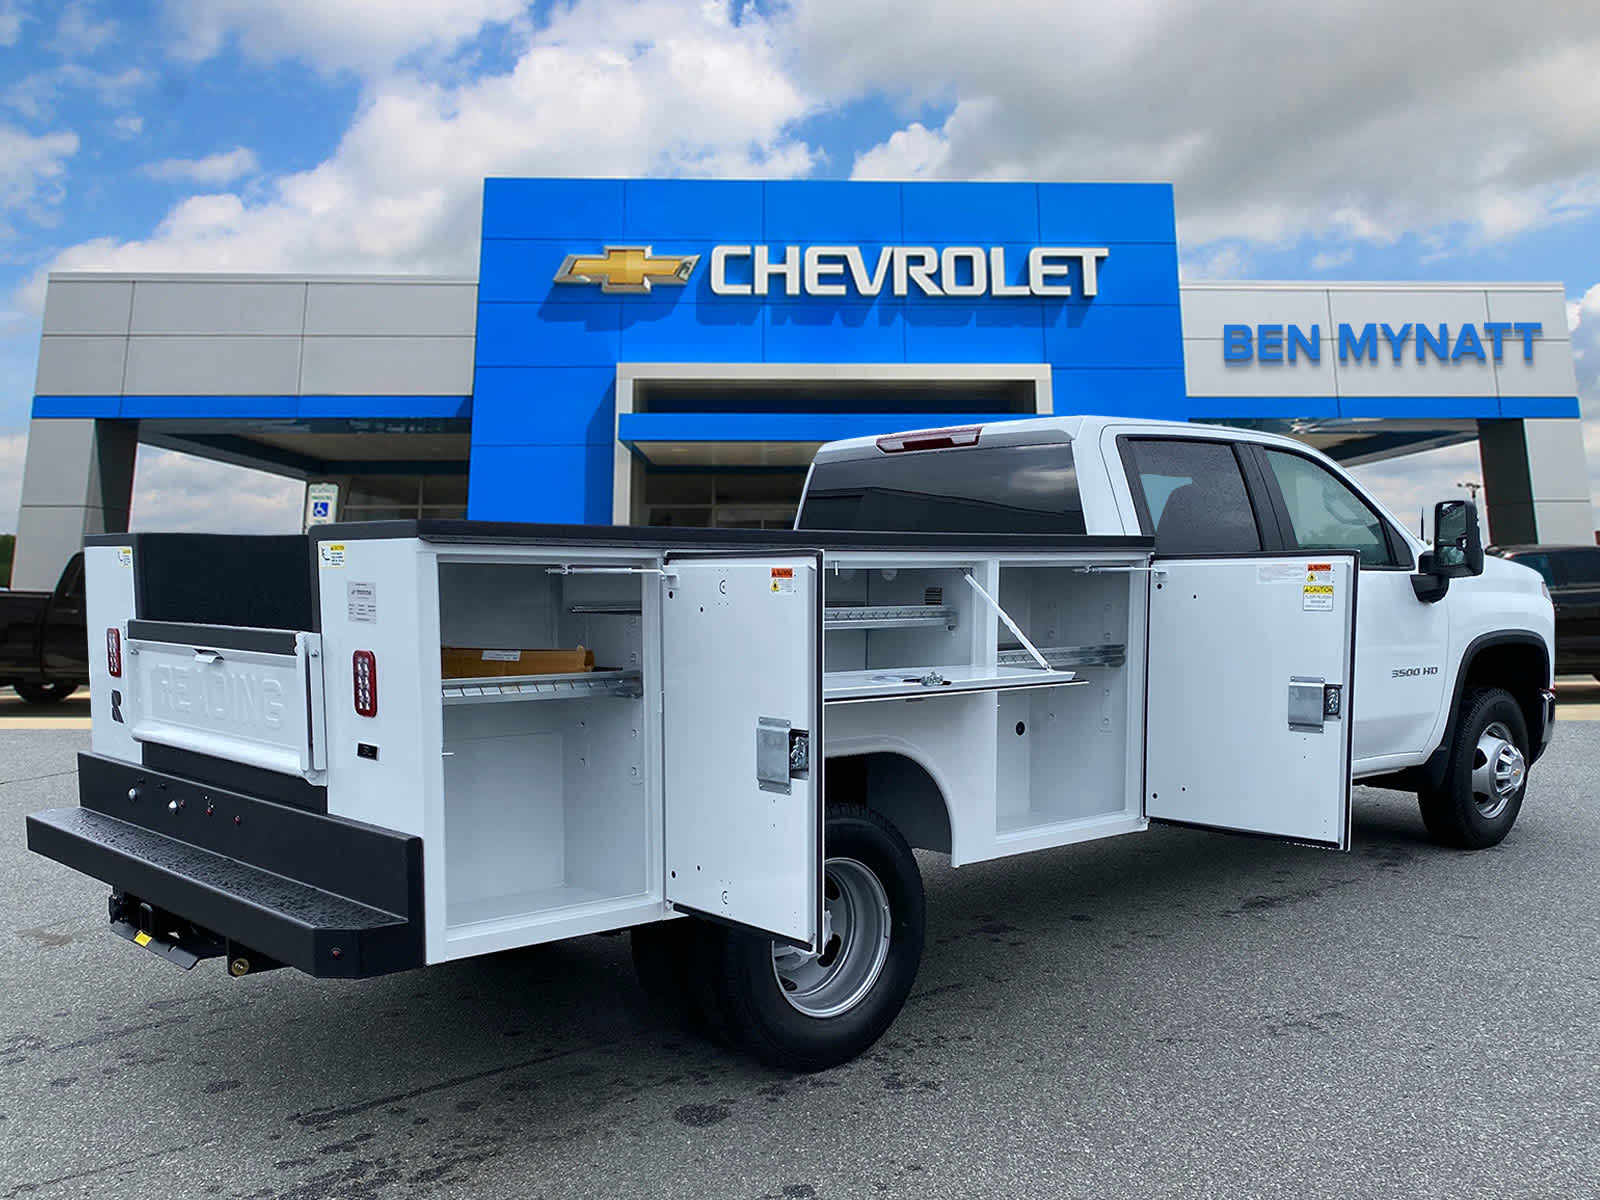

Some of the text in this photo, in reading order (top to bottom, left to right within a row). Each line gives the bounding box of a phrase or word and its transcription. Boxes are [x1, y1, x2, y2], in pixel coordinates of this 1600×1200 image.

[710, 245, 1110, 297] CHEVROLET
[1223, 322, 1543, 365] BEN MYNATT
[1391, 666, 1438, 678] 3500 HD
